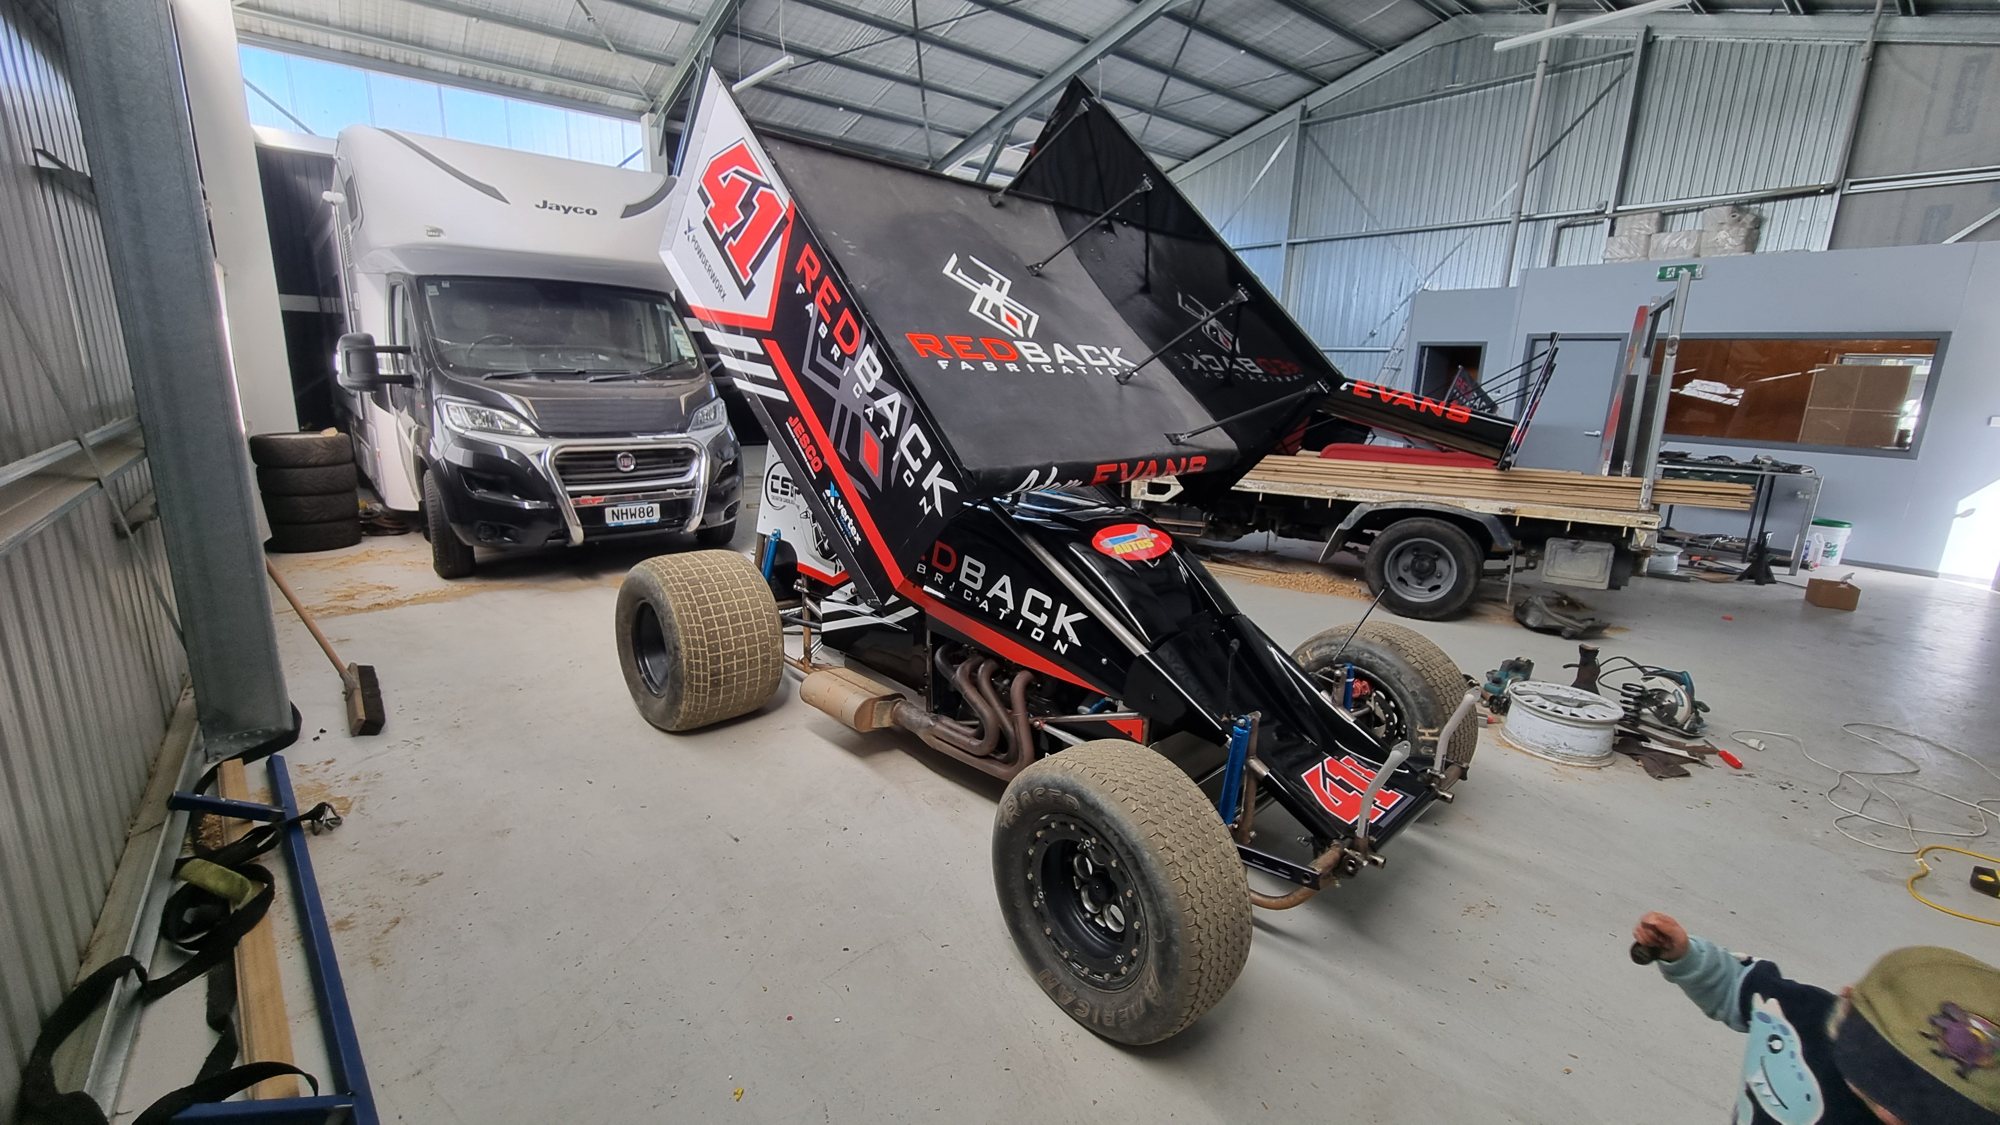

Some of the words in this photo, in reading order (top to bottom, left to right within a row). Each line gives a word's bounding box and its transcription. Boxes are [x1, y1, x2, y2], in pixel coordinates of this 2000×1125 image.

[534, 199, 599, 217] Jayco
[698, 137, 790, 300] 41
[689, 234, 728, 303] POWDERWORX
[905, 332, 1138, 368] REDBACK
[795, 242, 959, 518] REDBACK
[795, 282, 933, 516] FABRICATION
[1352, 379, 1472, 424] EVANS
[788, 416, 823, 473] JESCO
[1090, 455, 1207, 486] EVANS
[611, 506, 655, 522] NHW80
[837, 498, 862, 546] vertex
[1113, 538, 1155, 555] AUTOS
[916, 563, 1069, 655] BRICATION
[921, 540, 1088, 647] DBACK
[1301, 755, 1404, 825] 41
